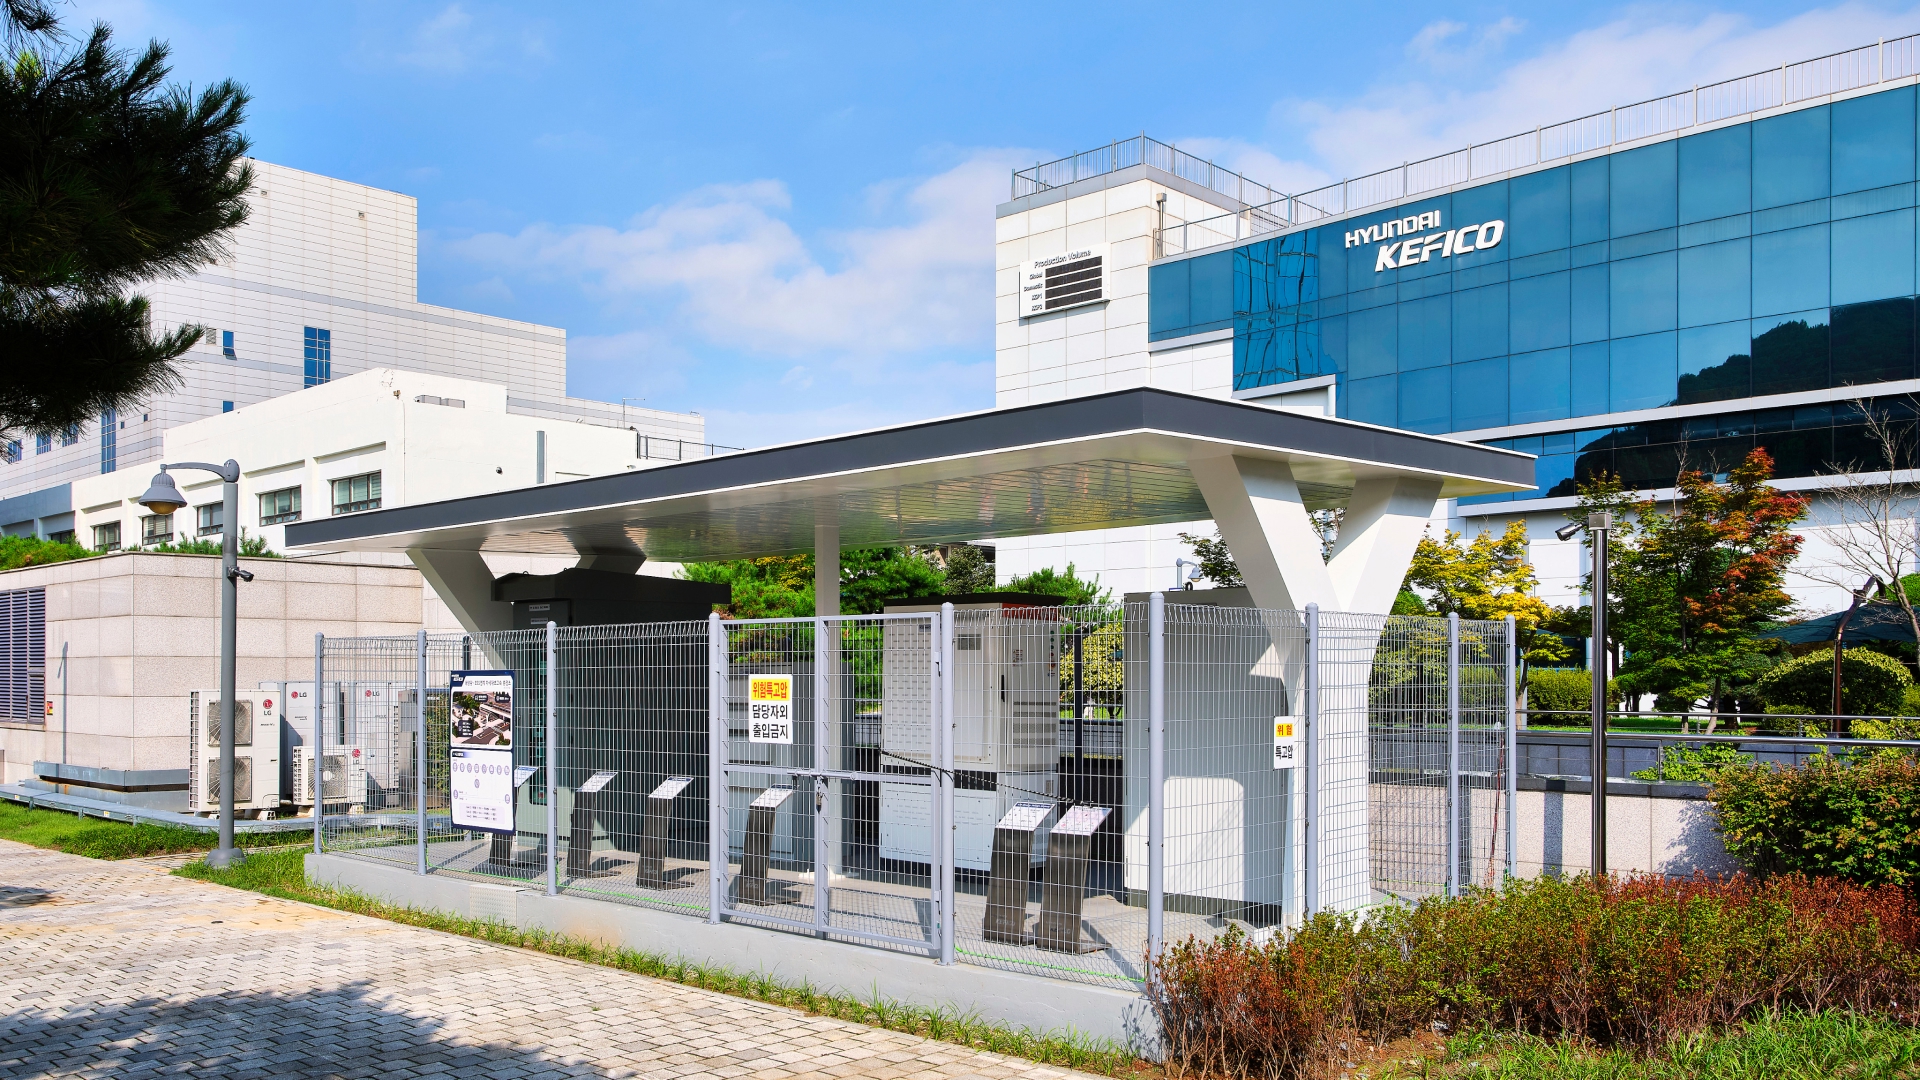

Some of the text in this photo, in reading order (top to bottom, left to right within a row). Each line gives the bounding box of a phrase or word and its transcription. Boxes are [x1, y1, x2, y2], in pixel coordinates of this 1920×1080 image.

[1345, 209, 1442, 249] HYUNDAI
[1374, 219, 1506, 273] KEFICO
[1034, 249, 1092, 269] Production Volume
[752, 681, 788, 699] 위험특고압
[752, 704, 788, 720] 담당자외
[752, 722, 789, 740] 출입금지
[1275, 745, 1293, 760] 특고압
